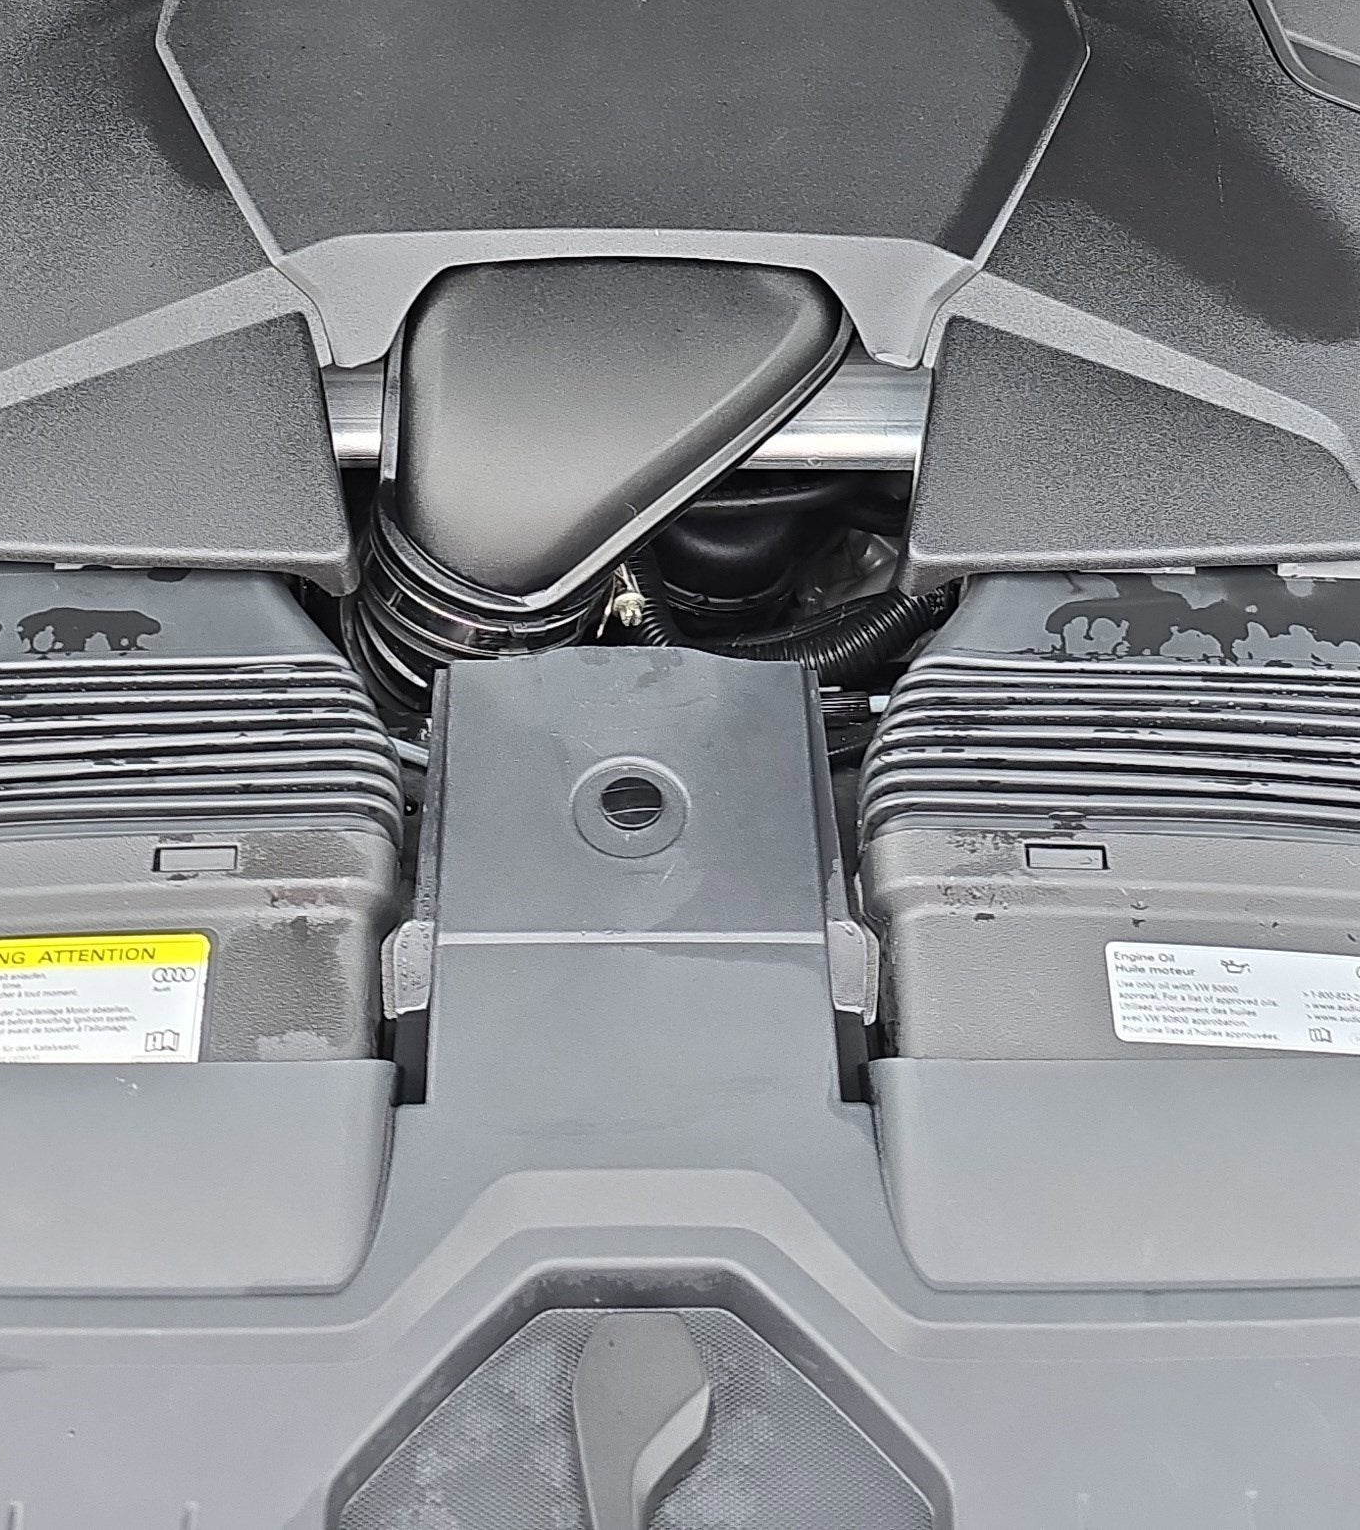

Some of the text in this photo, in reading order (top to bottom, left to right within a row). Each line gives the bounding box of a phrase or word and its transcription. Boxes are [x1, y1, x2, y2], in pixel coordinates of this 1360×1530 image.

[38, 947, 156, 965] ATTENTION
[1114, 951, 1175, 963] Engine Oil
[1115, 964, 1196, 977] Huile moteur
